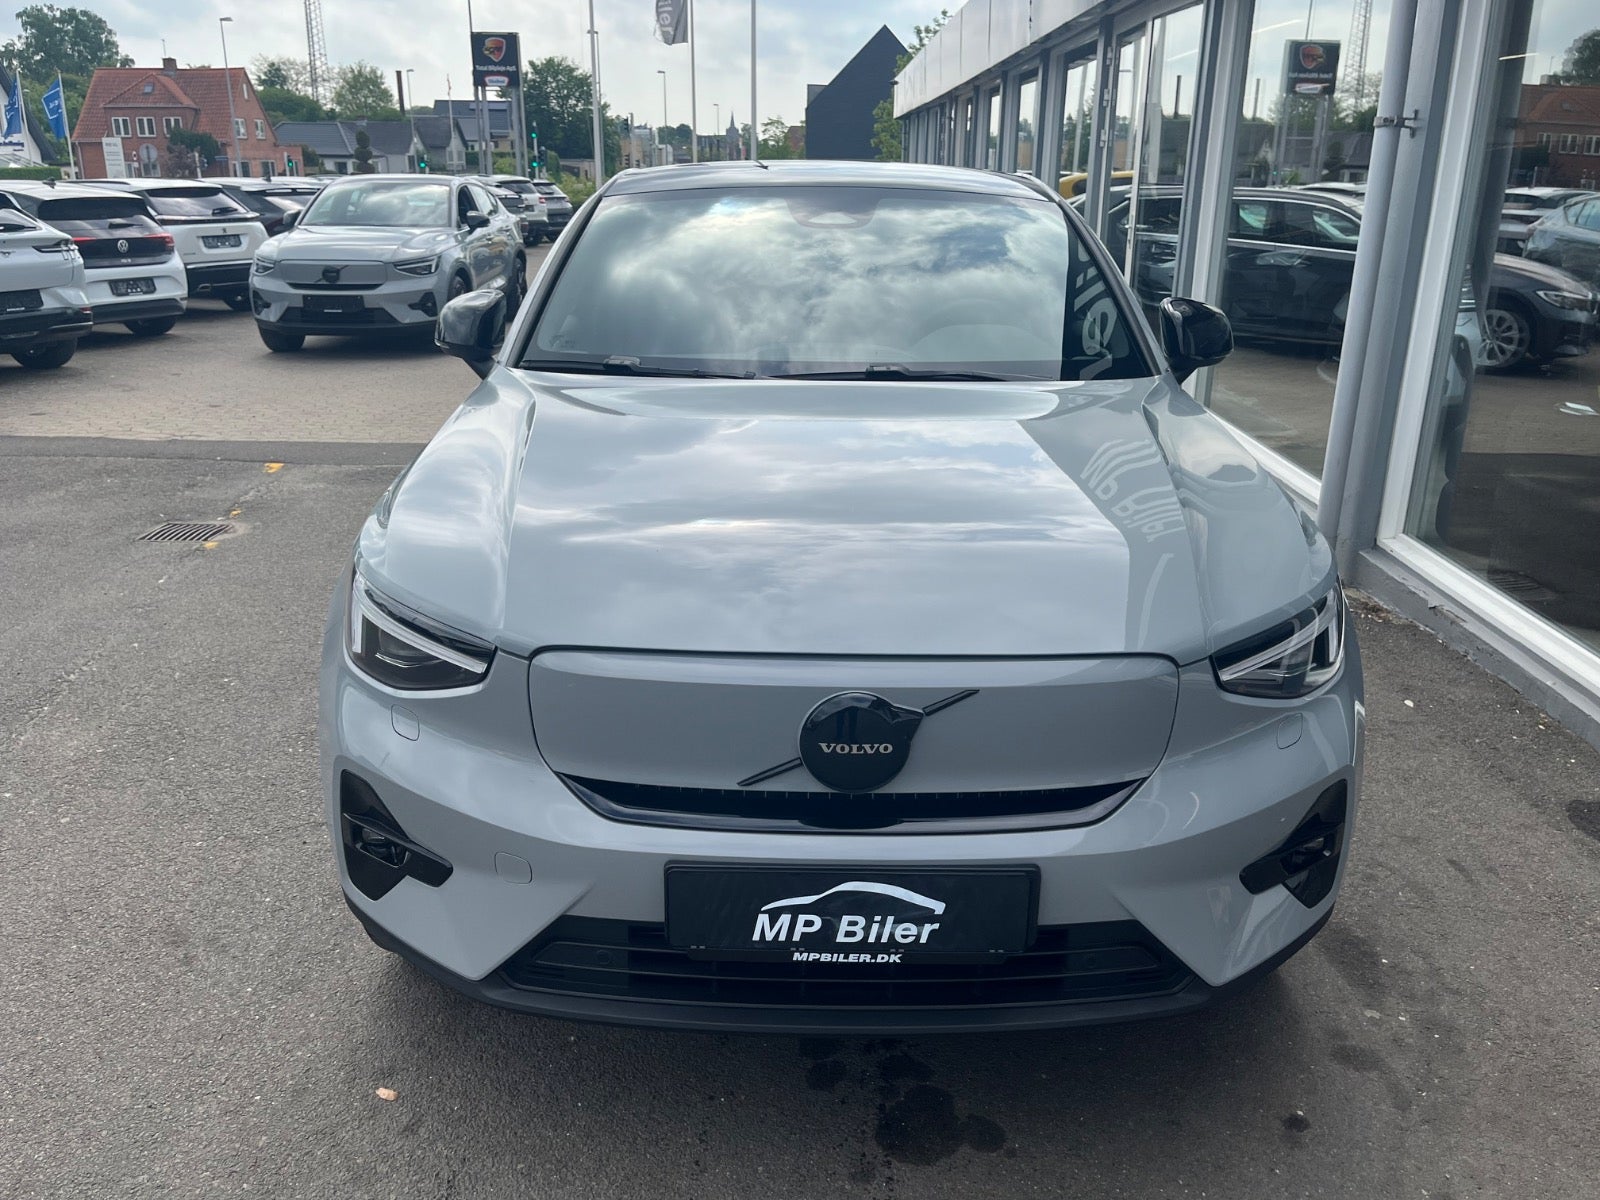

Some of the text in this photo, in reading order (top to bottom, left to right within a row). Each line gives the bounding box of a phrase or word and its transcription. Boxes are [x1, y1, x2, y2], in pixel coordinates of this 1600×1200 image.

[657, 0, 674, 35] iler
[818, 742, 893, 754] VOLVO
[752, 913, 939, 944] MP Biler
[792, 952, 902, 963] MPBILER.DK
